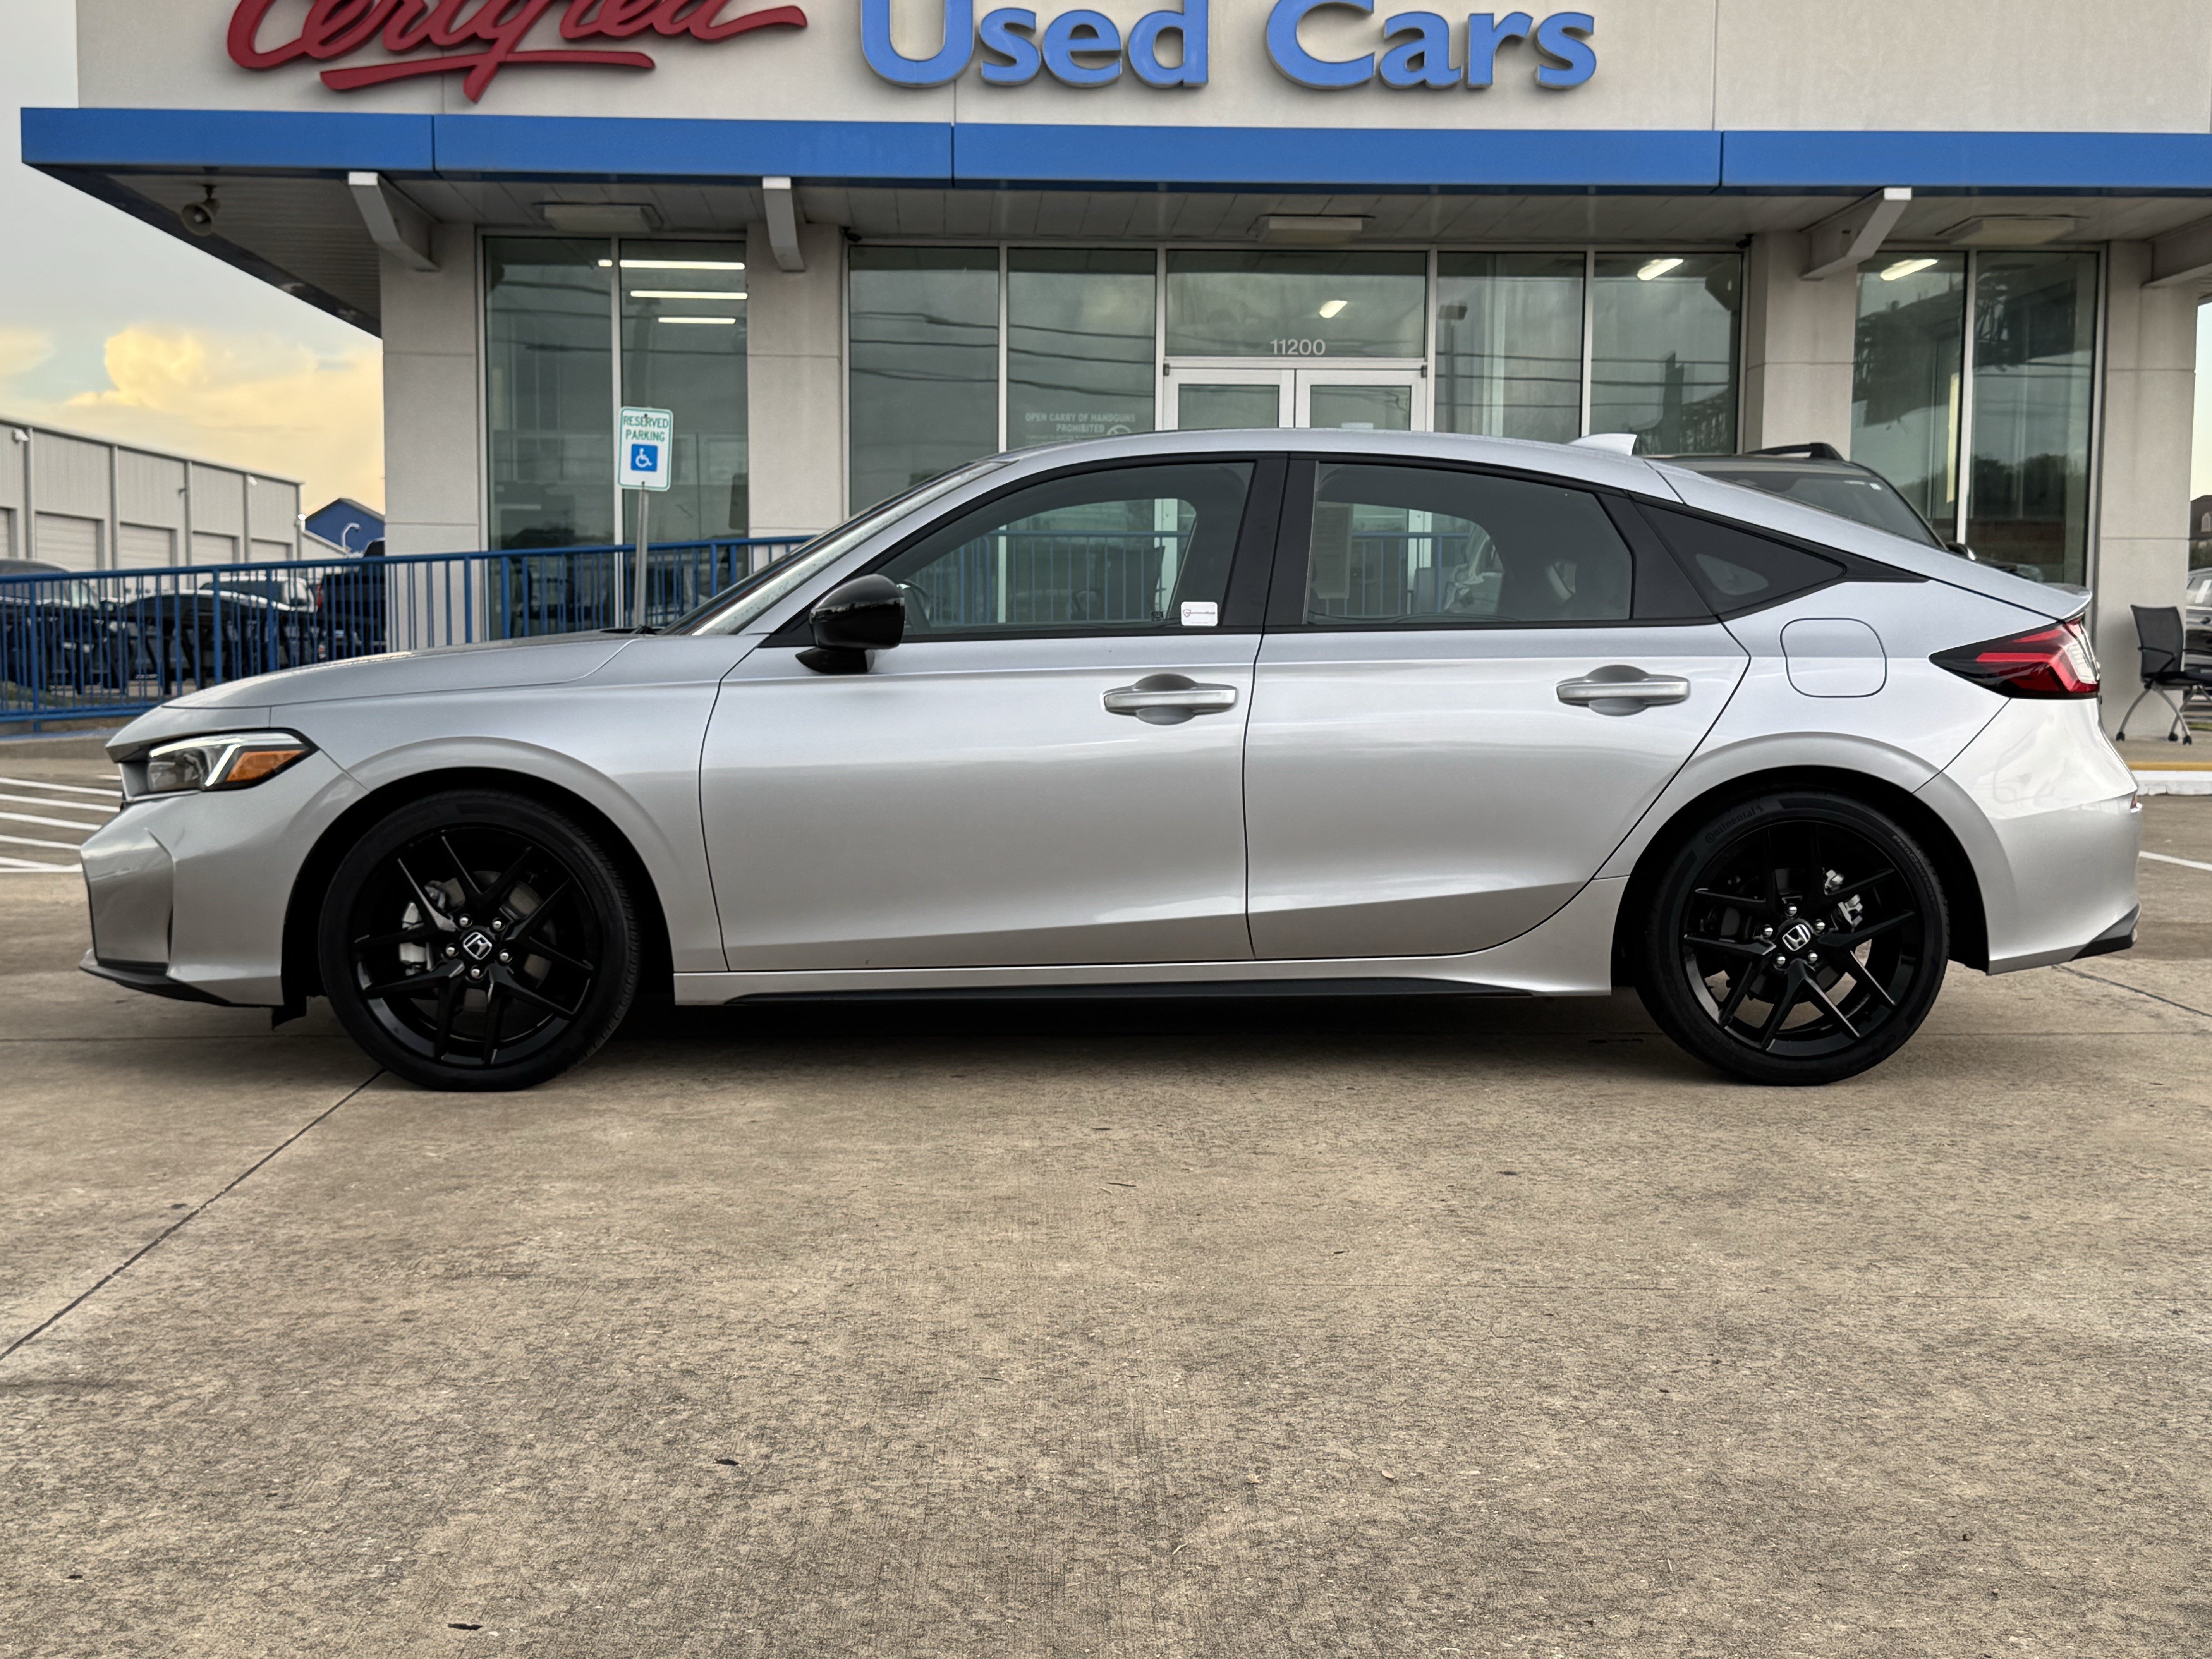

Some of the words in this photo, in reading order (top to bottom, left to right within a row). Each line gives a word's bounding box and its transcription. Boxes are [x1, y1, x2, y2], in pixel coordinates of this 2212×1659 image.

[861, 0, 1208, 88] Used
[1266, 0, 1597, 89] Cars
[1270, 338, 1326, 355] 11200
[623, 415, 669, 428] RESERVED
[1025, 412, 1047, 421] OPEN
[1049, 412, 1076, 422] CARRY
[1078, 413, 1089, 422] OF
[1091, 413, 1135, 422] HANDGUNS
[1056, 423, 1105, 433] PROHIBITED
[625, 429, 665, 442] PARKING
